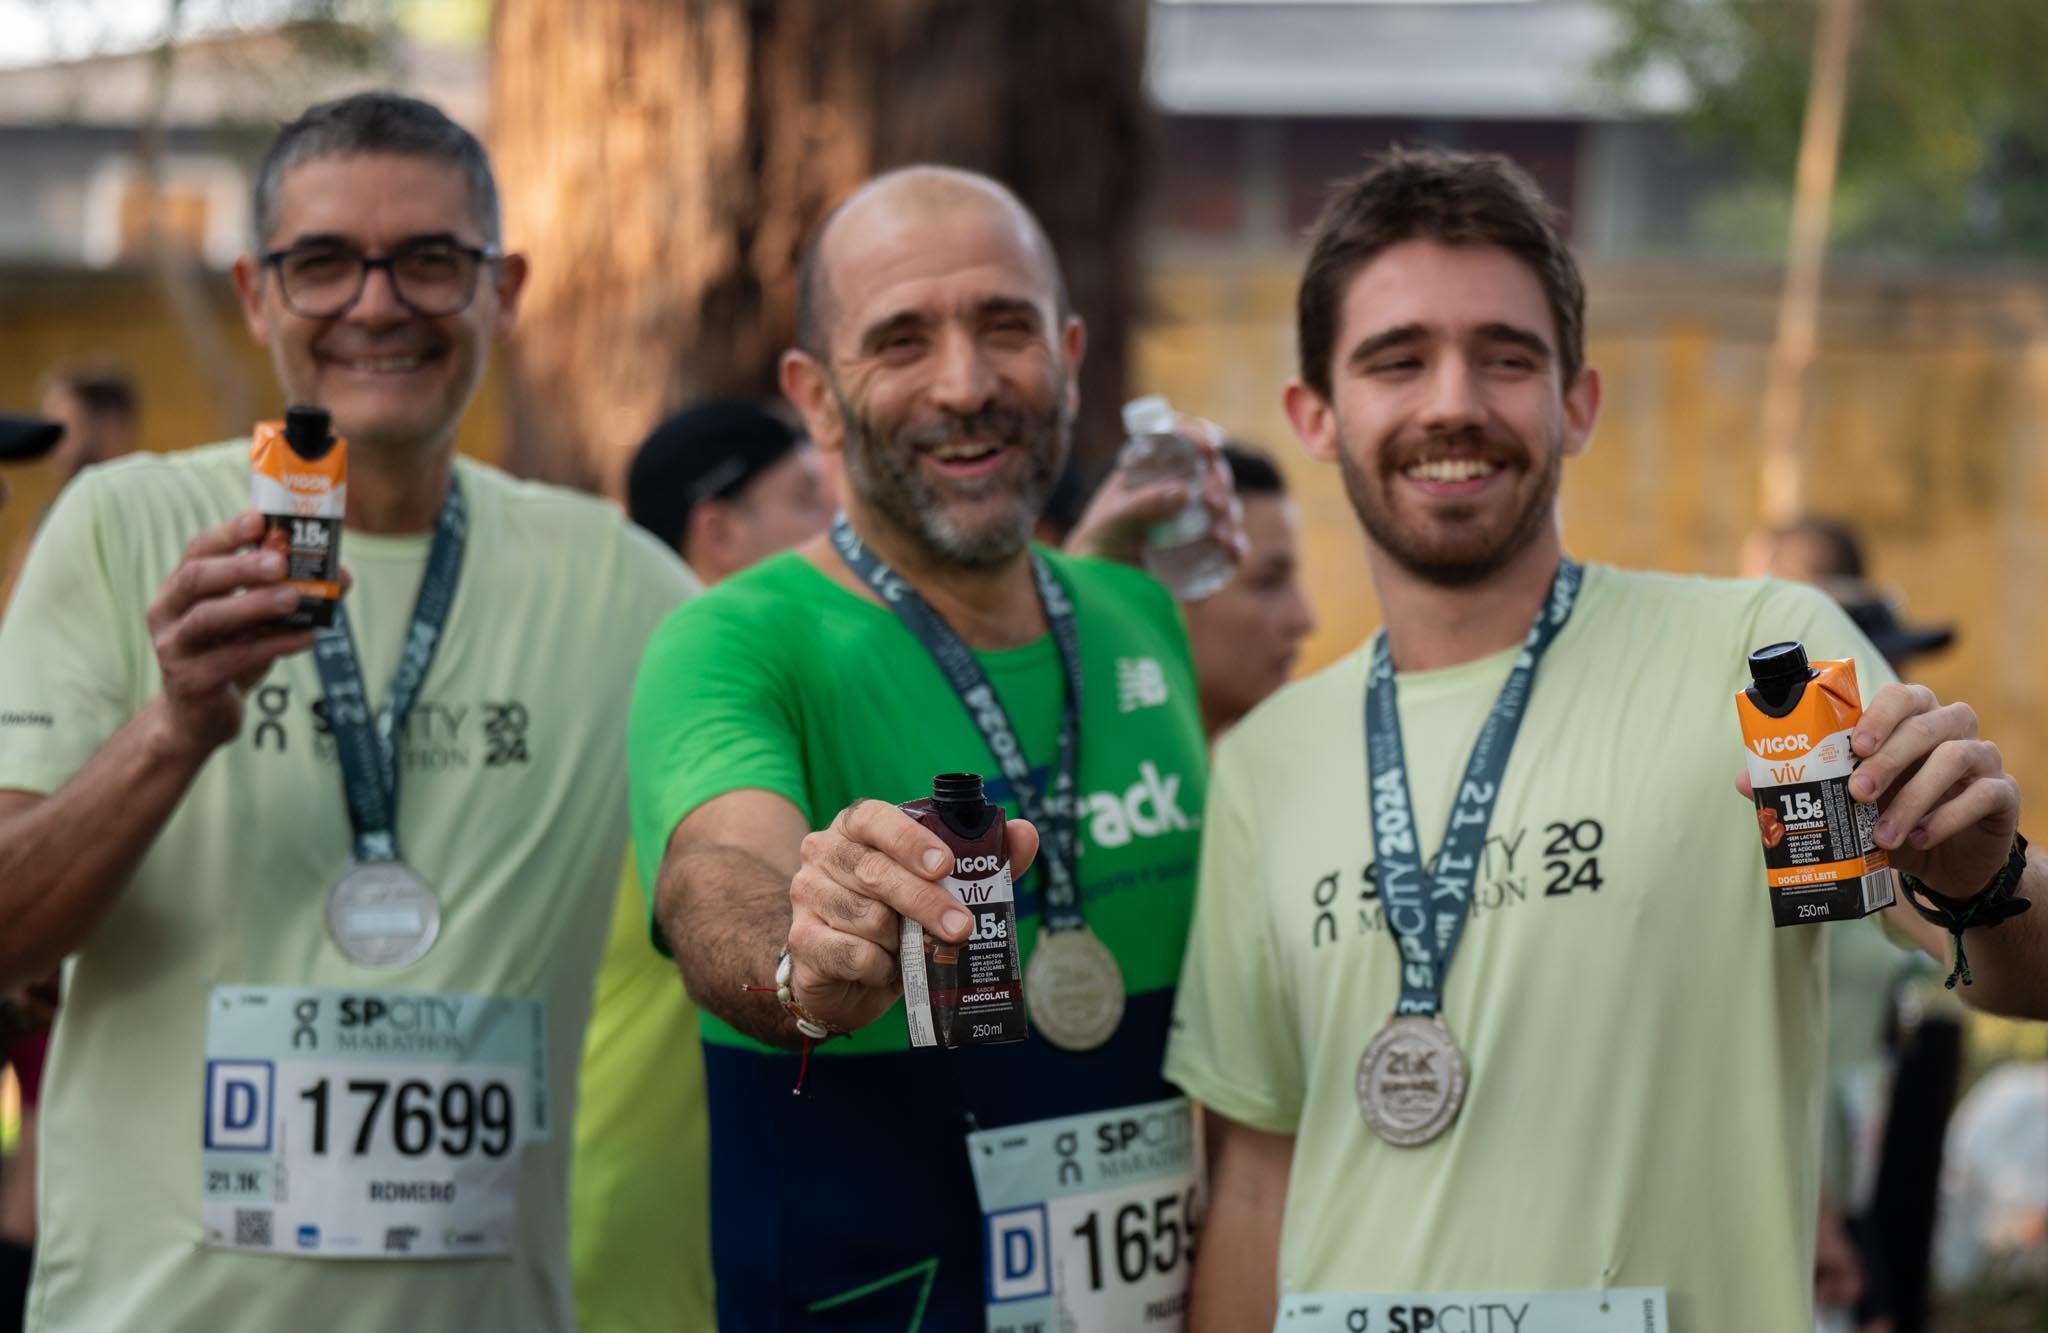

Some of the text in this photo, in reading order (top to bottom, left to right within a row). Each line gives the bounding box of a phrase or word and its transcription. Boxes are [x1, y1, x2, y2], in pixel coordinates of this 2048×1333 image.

[1752, 733, 1811, 756] VIGOR
[1374, 767, 1415, 856] 2024
[1780, 792, 1824, 822] 15g
[1431, 780, 1495, 901] 21.1K
[1544, 818, 1604, 857] 20
[1800, 833, 1822, 841] LACTOSE
[951, 854, 1000, 875] IGOR
[1544, 857, 1604, 897] 24
[1777, 871, 1838, 885] DOCE DE LEITE
[1798, 902, 1830, 918] 250ml
[968, 912, 1007, 940] 15g
[983, 952, 1004, 960] LACTOSE
[962, 991, 1010, 1003] CHOCOLATE
[339, 996, 463, 1029] SPCITY
[972, 1022, 1003, 1038] 250ml
[222, 1080, 260, 1132] D
[299, 1076, 515, 1157] 17699
[1002, 1225, 1036, 1282] D
[1388, 1303, 1530, 1333] SPCITY
